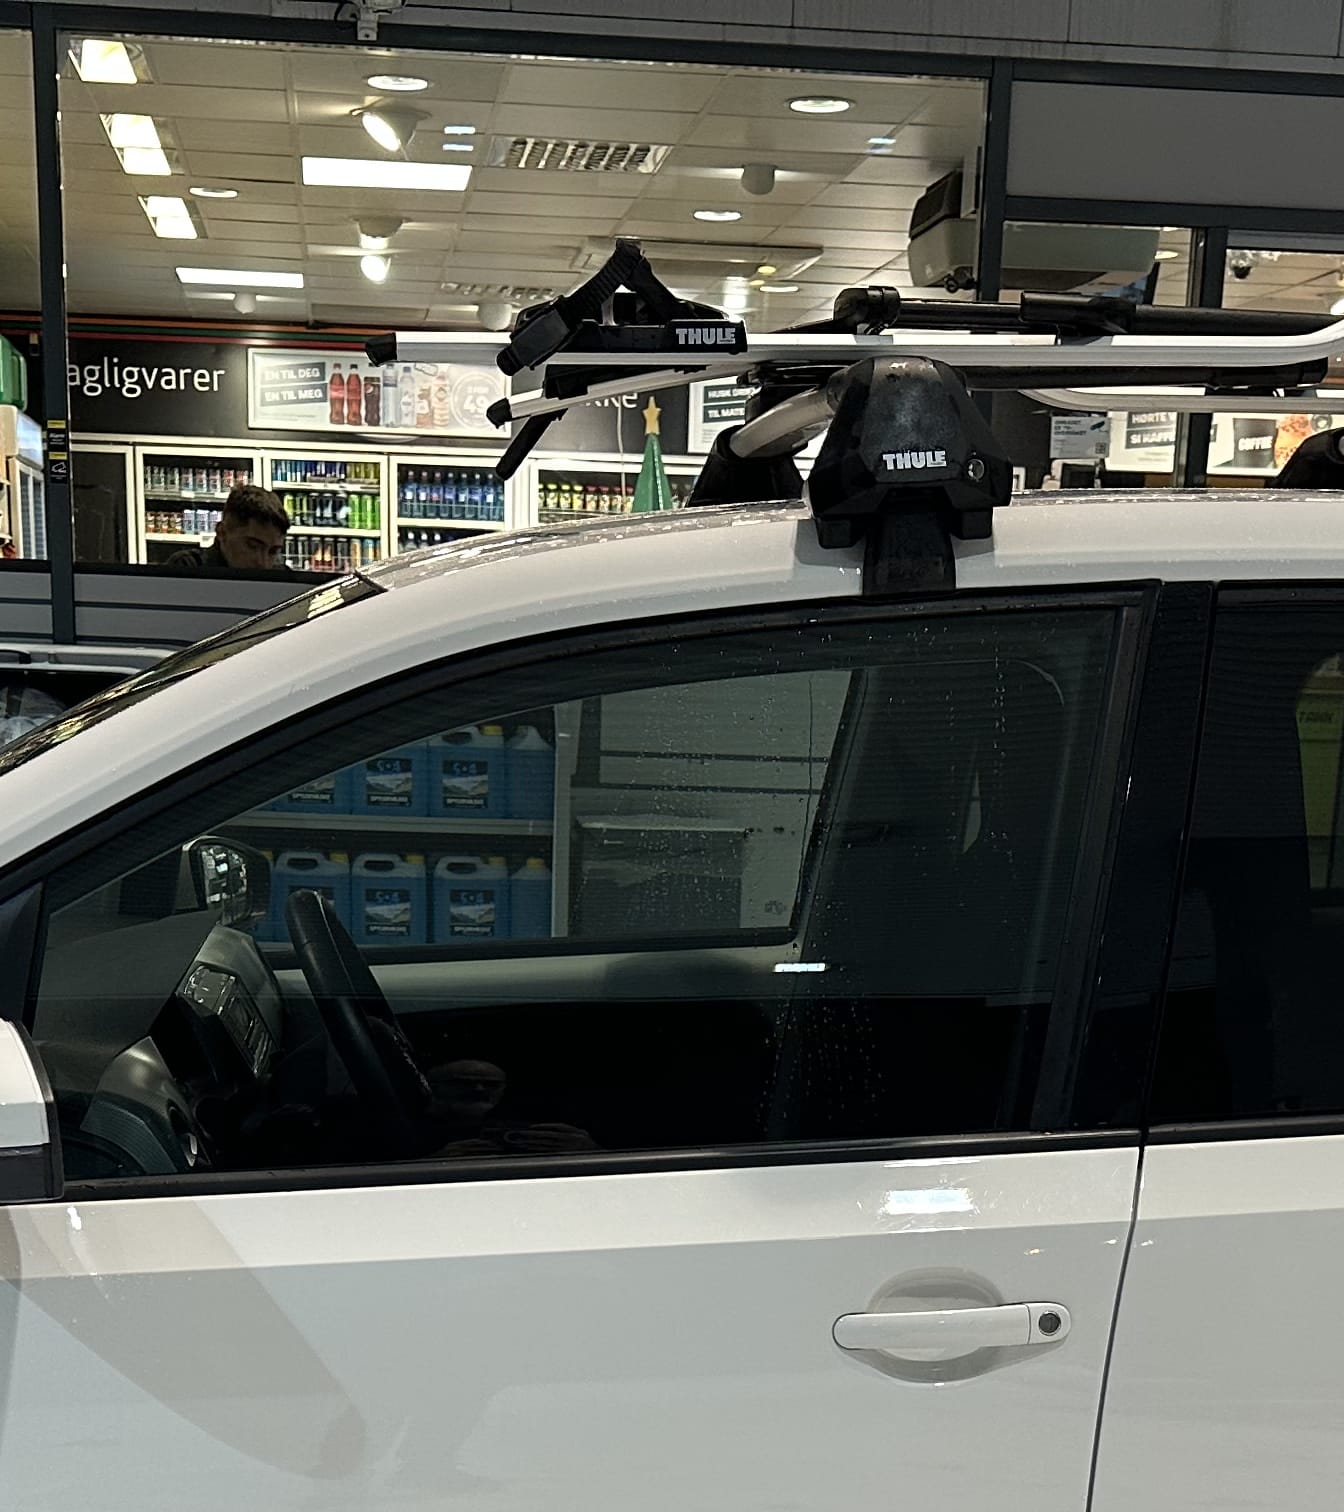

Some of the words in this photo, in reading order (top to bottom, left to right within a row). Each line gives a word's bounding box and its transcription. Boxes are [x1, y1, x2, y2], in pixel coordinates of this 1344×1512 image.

[675, 327, 736, 345] THULE
[298, 368, 320, 378] DEG
[882, 450, 947, 471] THULE
